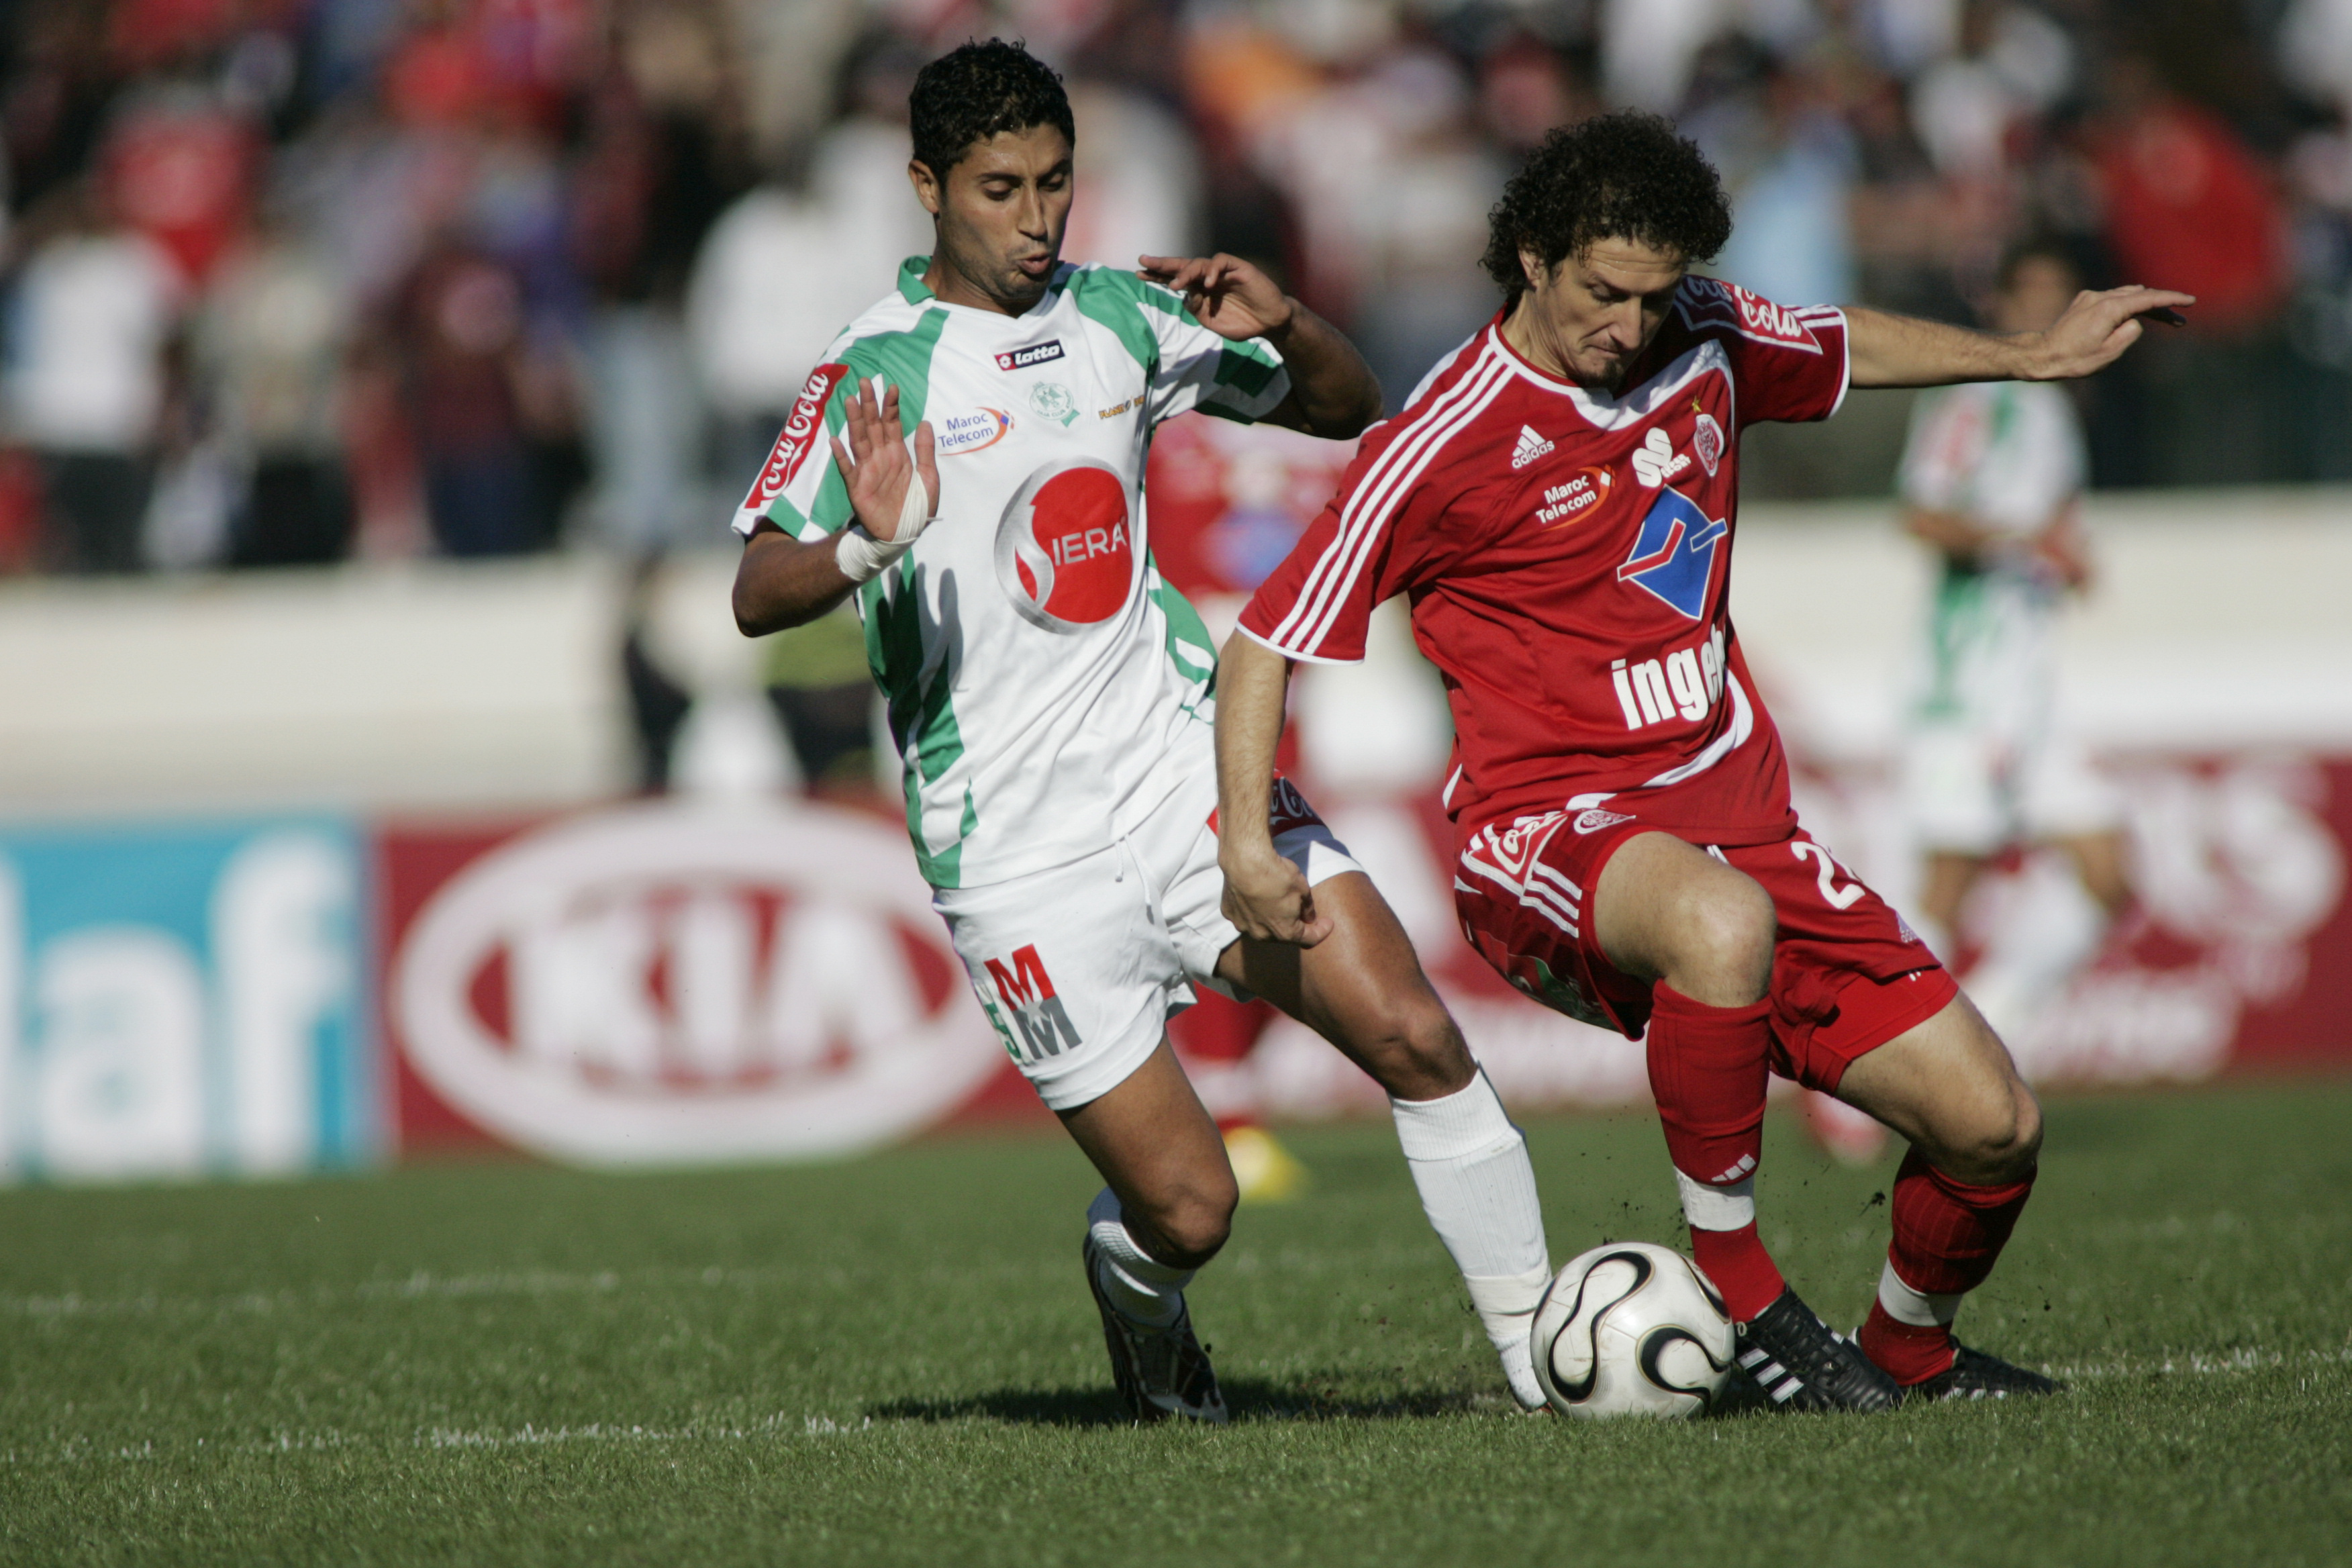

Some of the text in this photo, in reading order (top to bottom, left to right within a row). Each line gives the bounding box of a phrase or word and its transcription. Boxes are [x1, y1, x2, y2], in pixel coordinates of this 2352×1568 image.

[1734, 284, 1803, 337] Cola
[1015, 344, 1060, 365] lotto
[938, 427, 993, 448] Telecom
[946, 413, 988, 431] Maroc
[1512, 440, 1555, 469] adidas
[1544, 475, 1589, 504] Maroc
[1535, 490, 1597, 524] Telecom
[1791, 841, 1865, 910] 2
[511, 896, 936, 1079] KIA
[0, 832, 356, 1178] af
